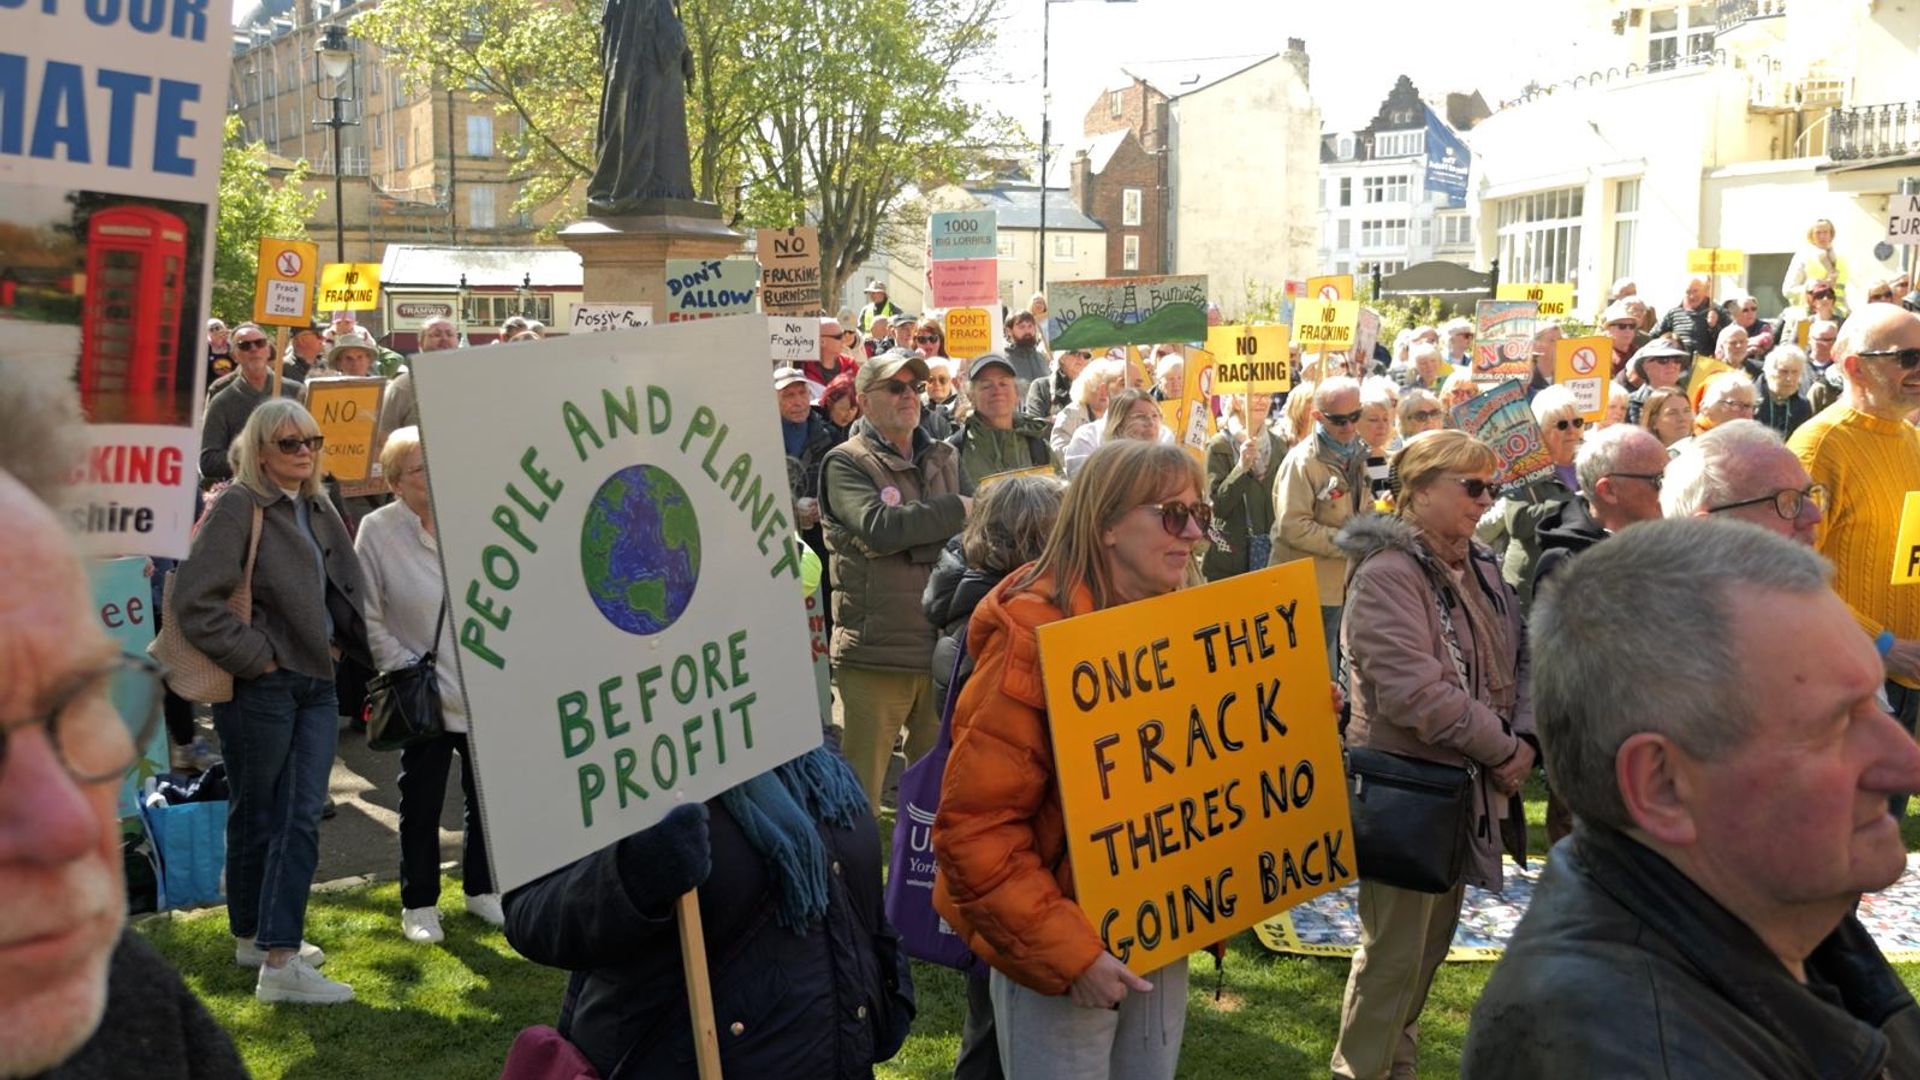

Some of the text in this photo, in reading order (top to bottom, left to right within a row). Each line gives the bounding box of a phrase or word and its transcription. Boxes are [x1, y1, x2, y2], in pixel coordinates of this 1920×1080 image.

[944, 219, 978, 232] 1000
[774, 237, 805, 253] NO
[345, 272, 359, 285] NO
[667, 261, 722, 296] DON'T
[275, 284, 299, 293] Frack
[325, 290, 373, 303] FRACKING
[1527, 289, 1544, 300] NO
[277, 294, 296, 302] Free
[680, 289, 753, 309] ALLOW
[274, 305, 296, 313] Zone
[400, 306, 449, 317] TRAMWAY
[1321, 308, 1336, 323] NO
[785, 323, 802, 334] No
[950, 329, 986, 339] FRACK
[1300, 325, 1350, 341] FRACKING
[771, 333, 815, 352] Fracking
[1236, 337, 1257, 355] NO
[323, 400, 357, 424] NO
[461, 384, 801, 669] PEOPLE AND PLANET
[1072, 600, 1299, 712] ONCE THEY
[556, 629, 750, 759] BEFORE
[1094, 678, 1289, 800] FRACK
[578, 692, 758, 828] PROFIT
[1090, 759, 1315, 878] THERE'S NO
[1101, 829, 1350, 965] GOING BACK
